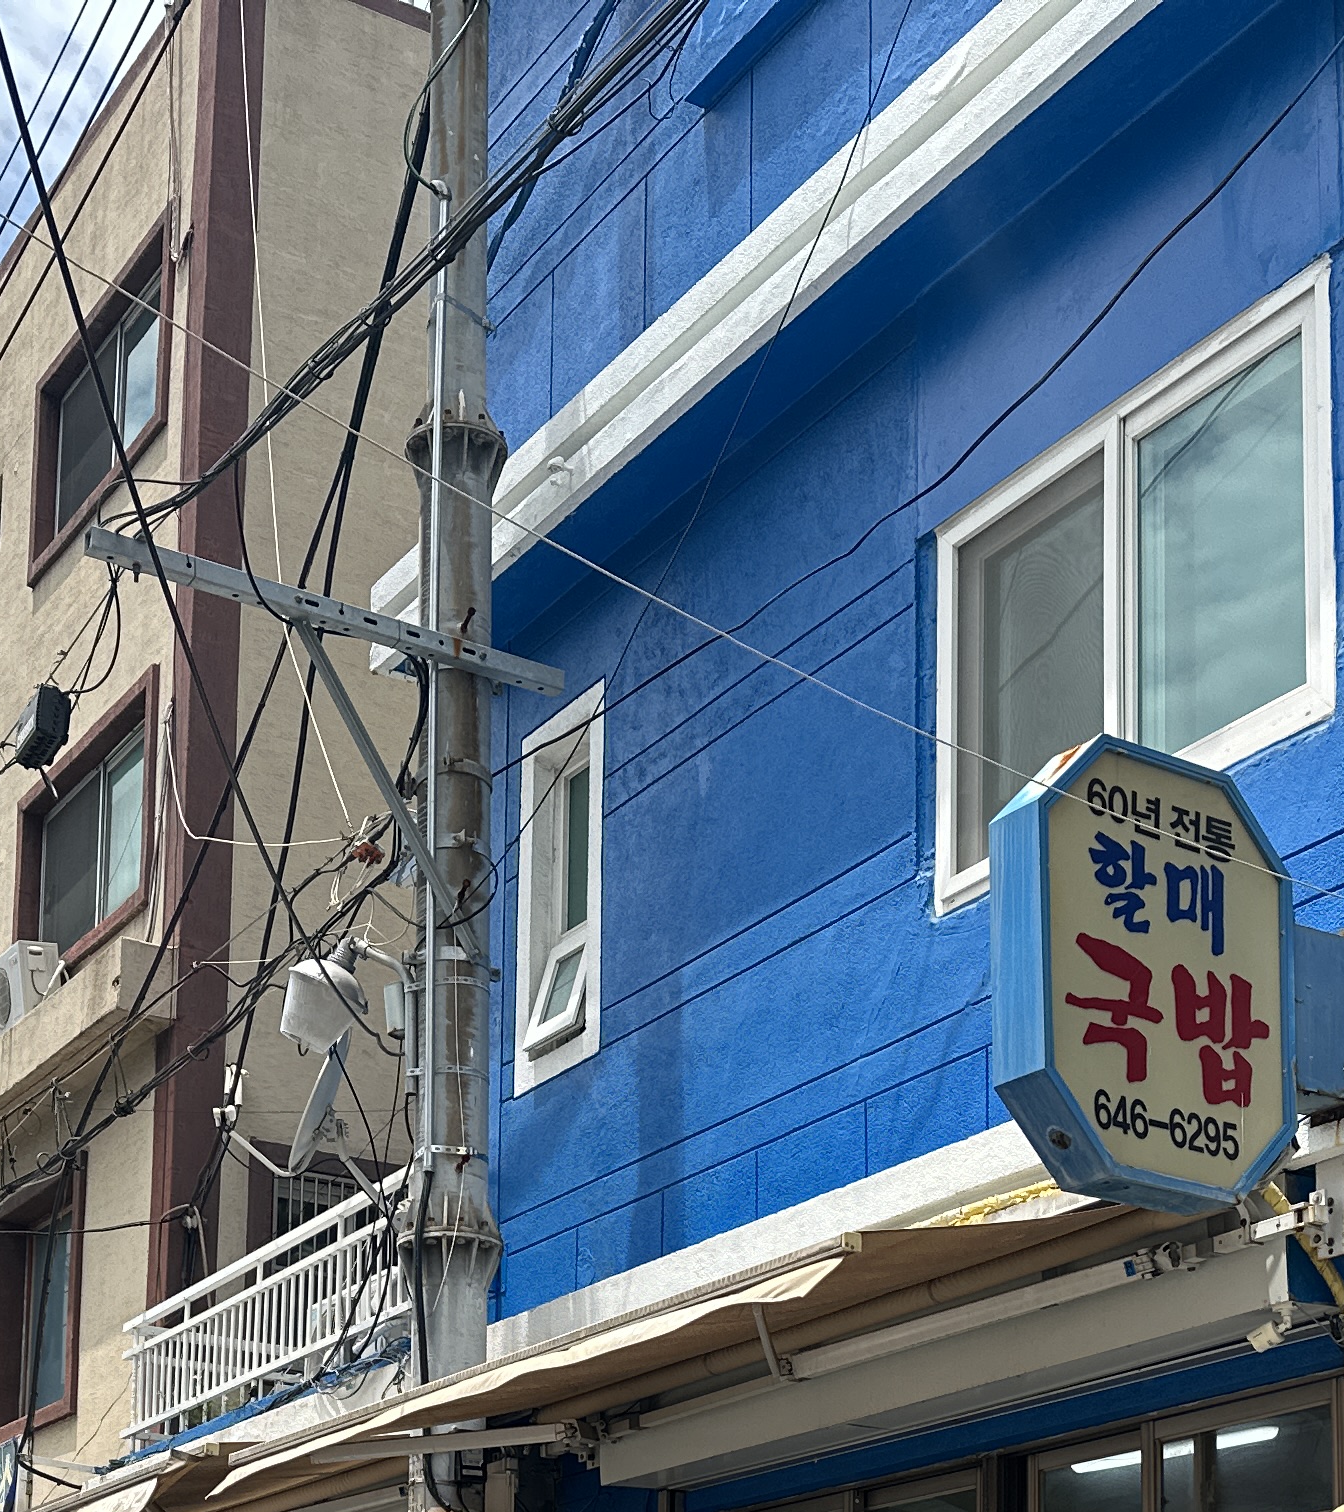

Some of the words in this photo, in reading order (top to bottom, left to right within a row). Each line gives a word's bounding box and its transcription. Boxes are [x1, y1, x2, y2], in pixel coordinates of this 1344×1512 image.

[1086, 777, 1161, 842] 60년
[1169, 804, 1236, 863] 전통
[1088, 831, 1226, 957] 할매
[1064, 931, 1270, 1109] 국밥
[1093, 1088, 1241, 1161] 646-6295
